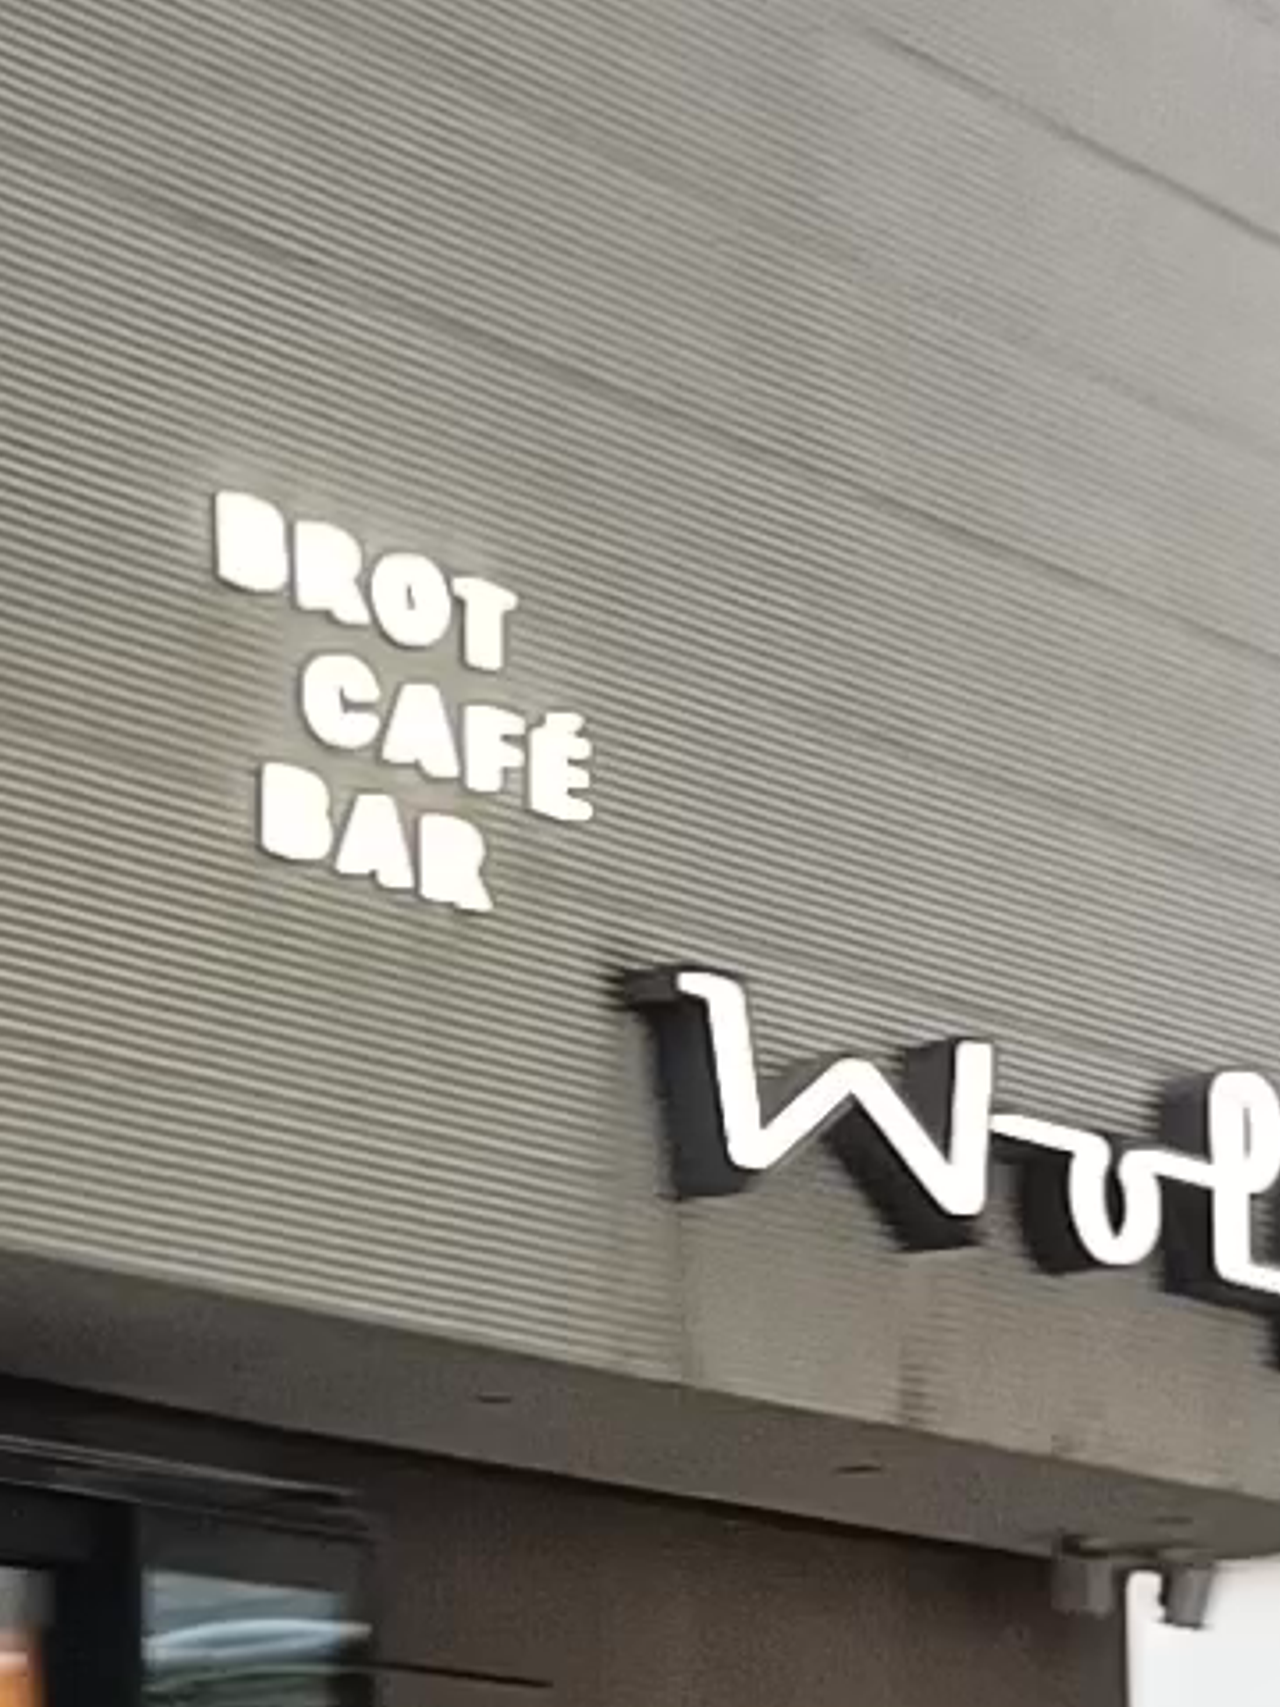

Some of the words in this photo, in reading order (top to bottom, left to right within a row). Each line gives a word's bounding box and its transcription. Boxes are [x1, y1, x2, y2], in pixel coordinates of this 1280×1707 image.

[217, 492, 517, 670] BROT
[302, 655, 593, 821] CAFÉ
[261, 762, 493, 912] BAR
